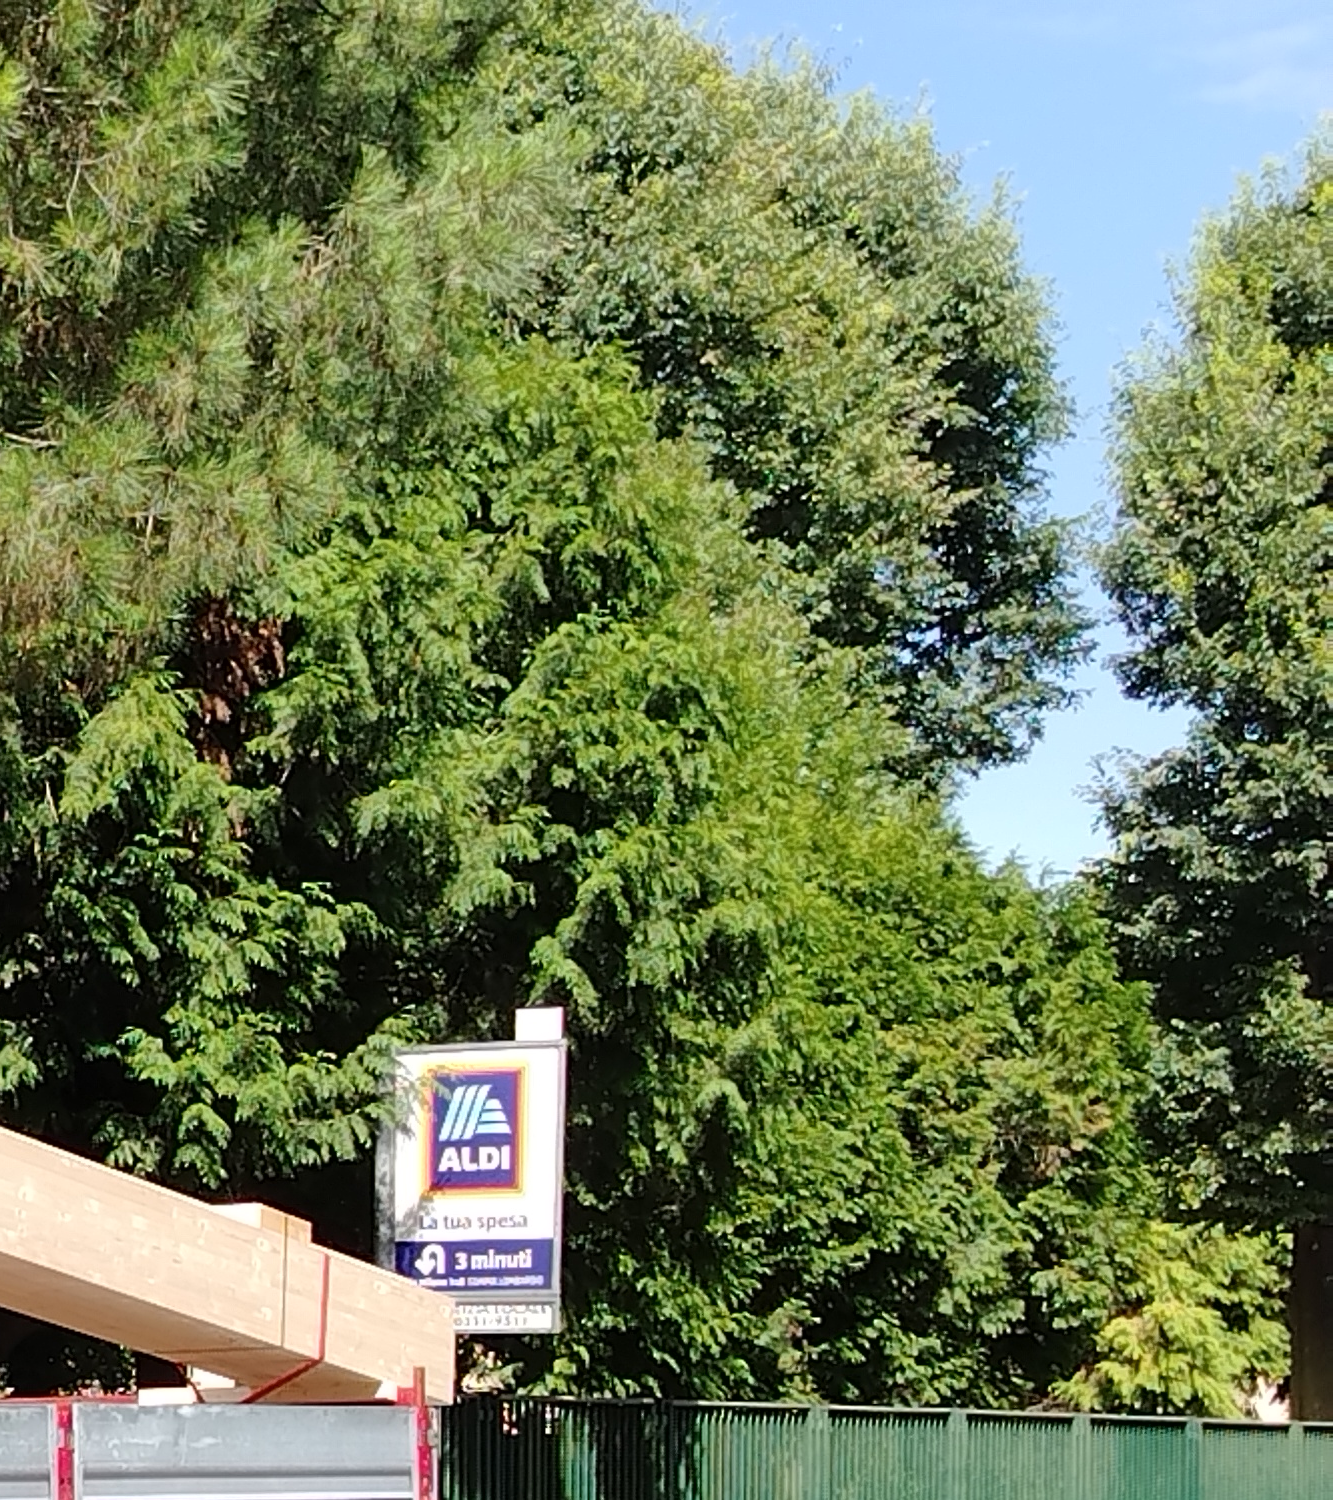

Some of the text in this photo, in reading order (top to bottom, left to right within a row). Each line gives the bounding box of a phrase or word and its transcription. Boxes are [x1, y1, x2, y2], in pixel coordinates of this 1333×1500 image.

[438, 1145, 511, 1172] ALDI
[419, 1214, 529, 1233] La tua spesa
[454, 1249, 533, 1271] 3 minuti
